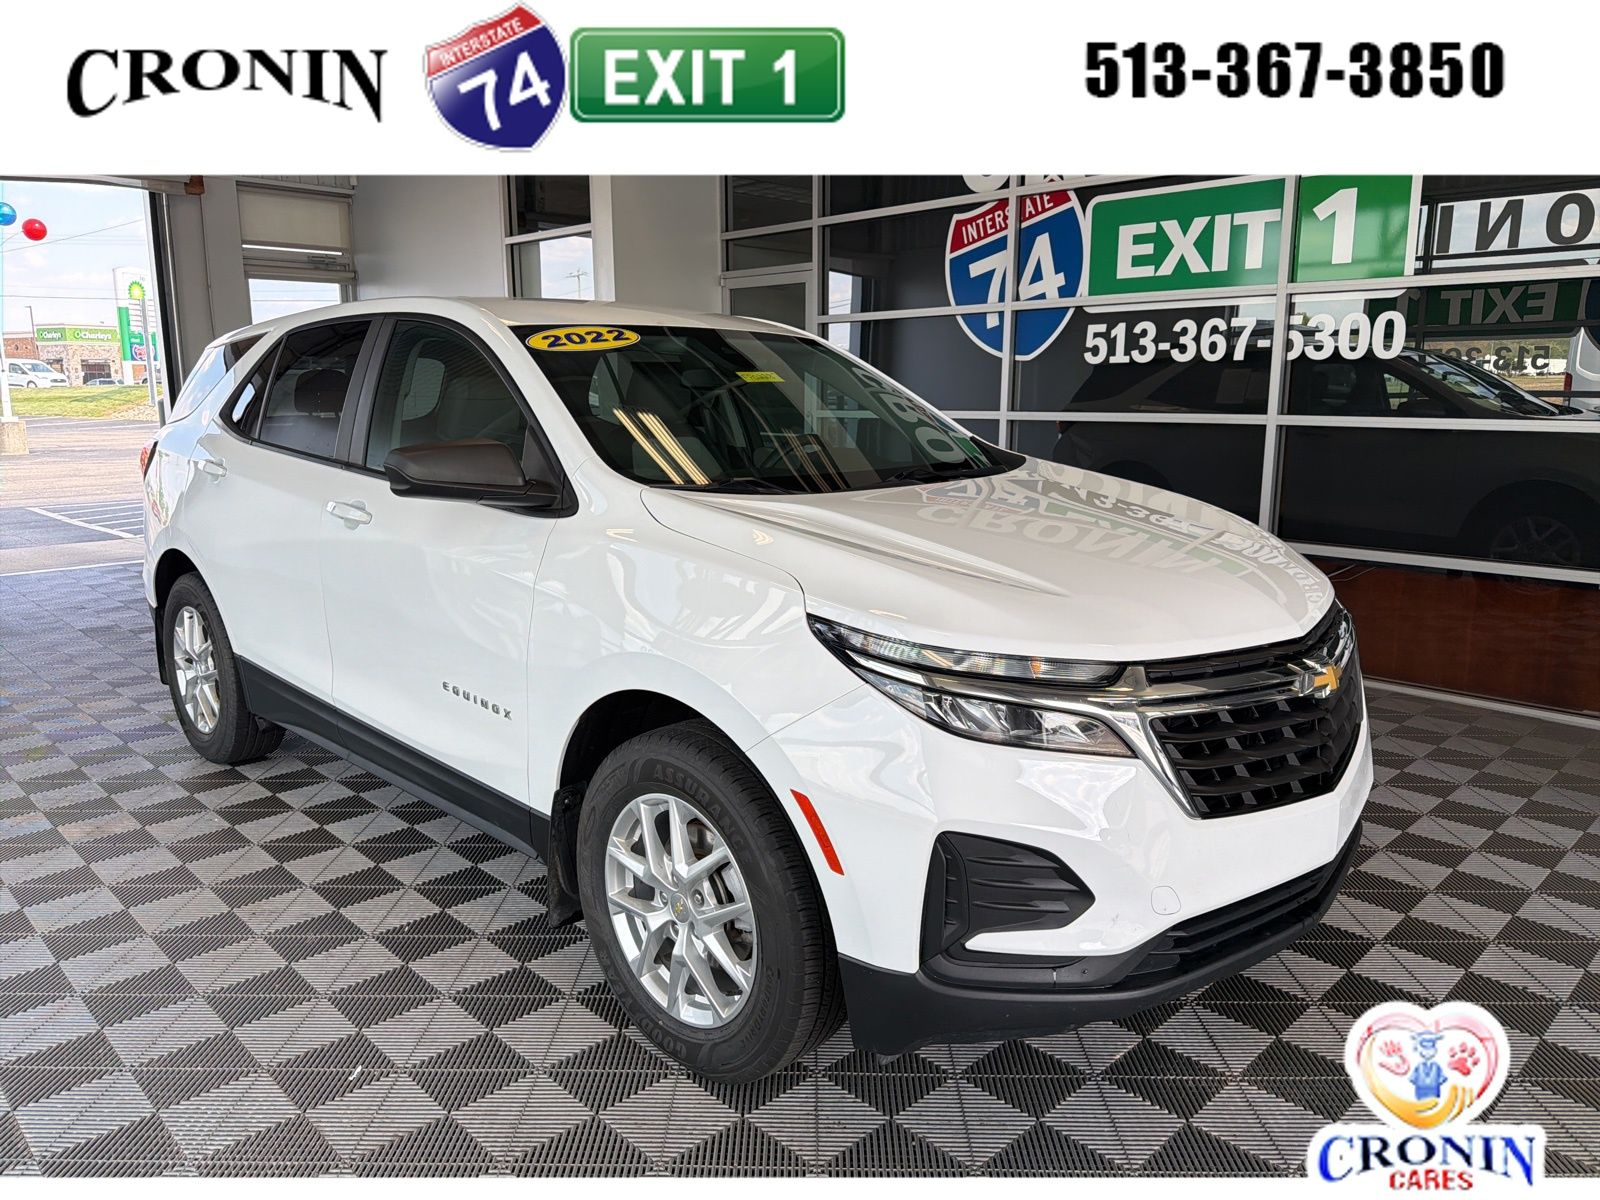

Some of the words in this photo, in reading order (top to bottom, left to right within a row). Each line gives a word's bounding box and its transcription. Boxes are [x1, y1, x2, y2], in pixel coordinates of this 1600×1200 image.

[961, 193, 1055, 246] INTERATE
[1116, 208, 1282, 280] EXIT
[1312, 187, 1358, 265] 1
[968, 231, 1067, 330] 74
[541, 329, 632, 349] 2022
[1083, 310, 1407, 365] 513-367-5300
[442, 681, 512, 721] EQUINOX
[652, 763, 754, 866] ASSURANCE
